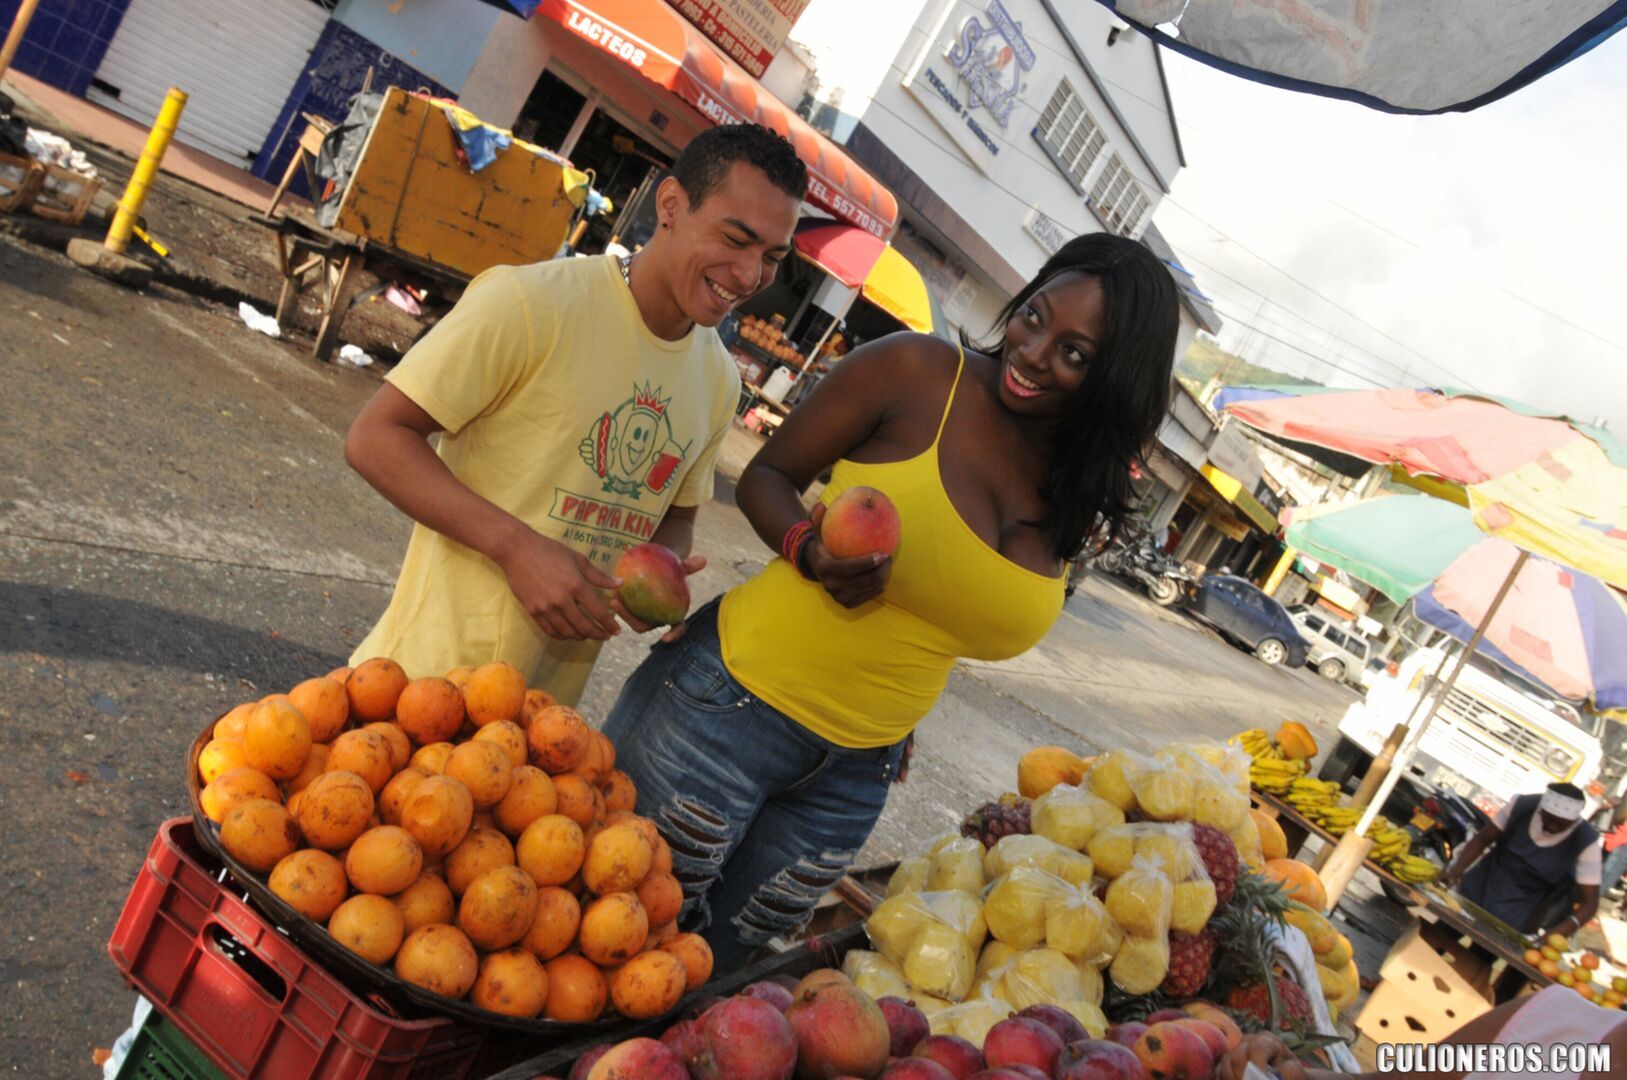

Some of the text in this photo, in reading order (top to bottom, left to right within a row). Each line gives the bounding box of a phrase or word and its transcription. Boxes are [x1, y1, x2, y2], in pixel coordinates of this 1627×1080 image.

[567, 12, 647, 67] LACTEOS
[716, 12, 762, 55] DOMICILIO
[833, 195, 855, 219] 557
[856, 210, 884, 237] 7093
[561, 495, 622, 528] PAPAYA
